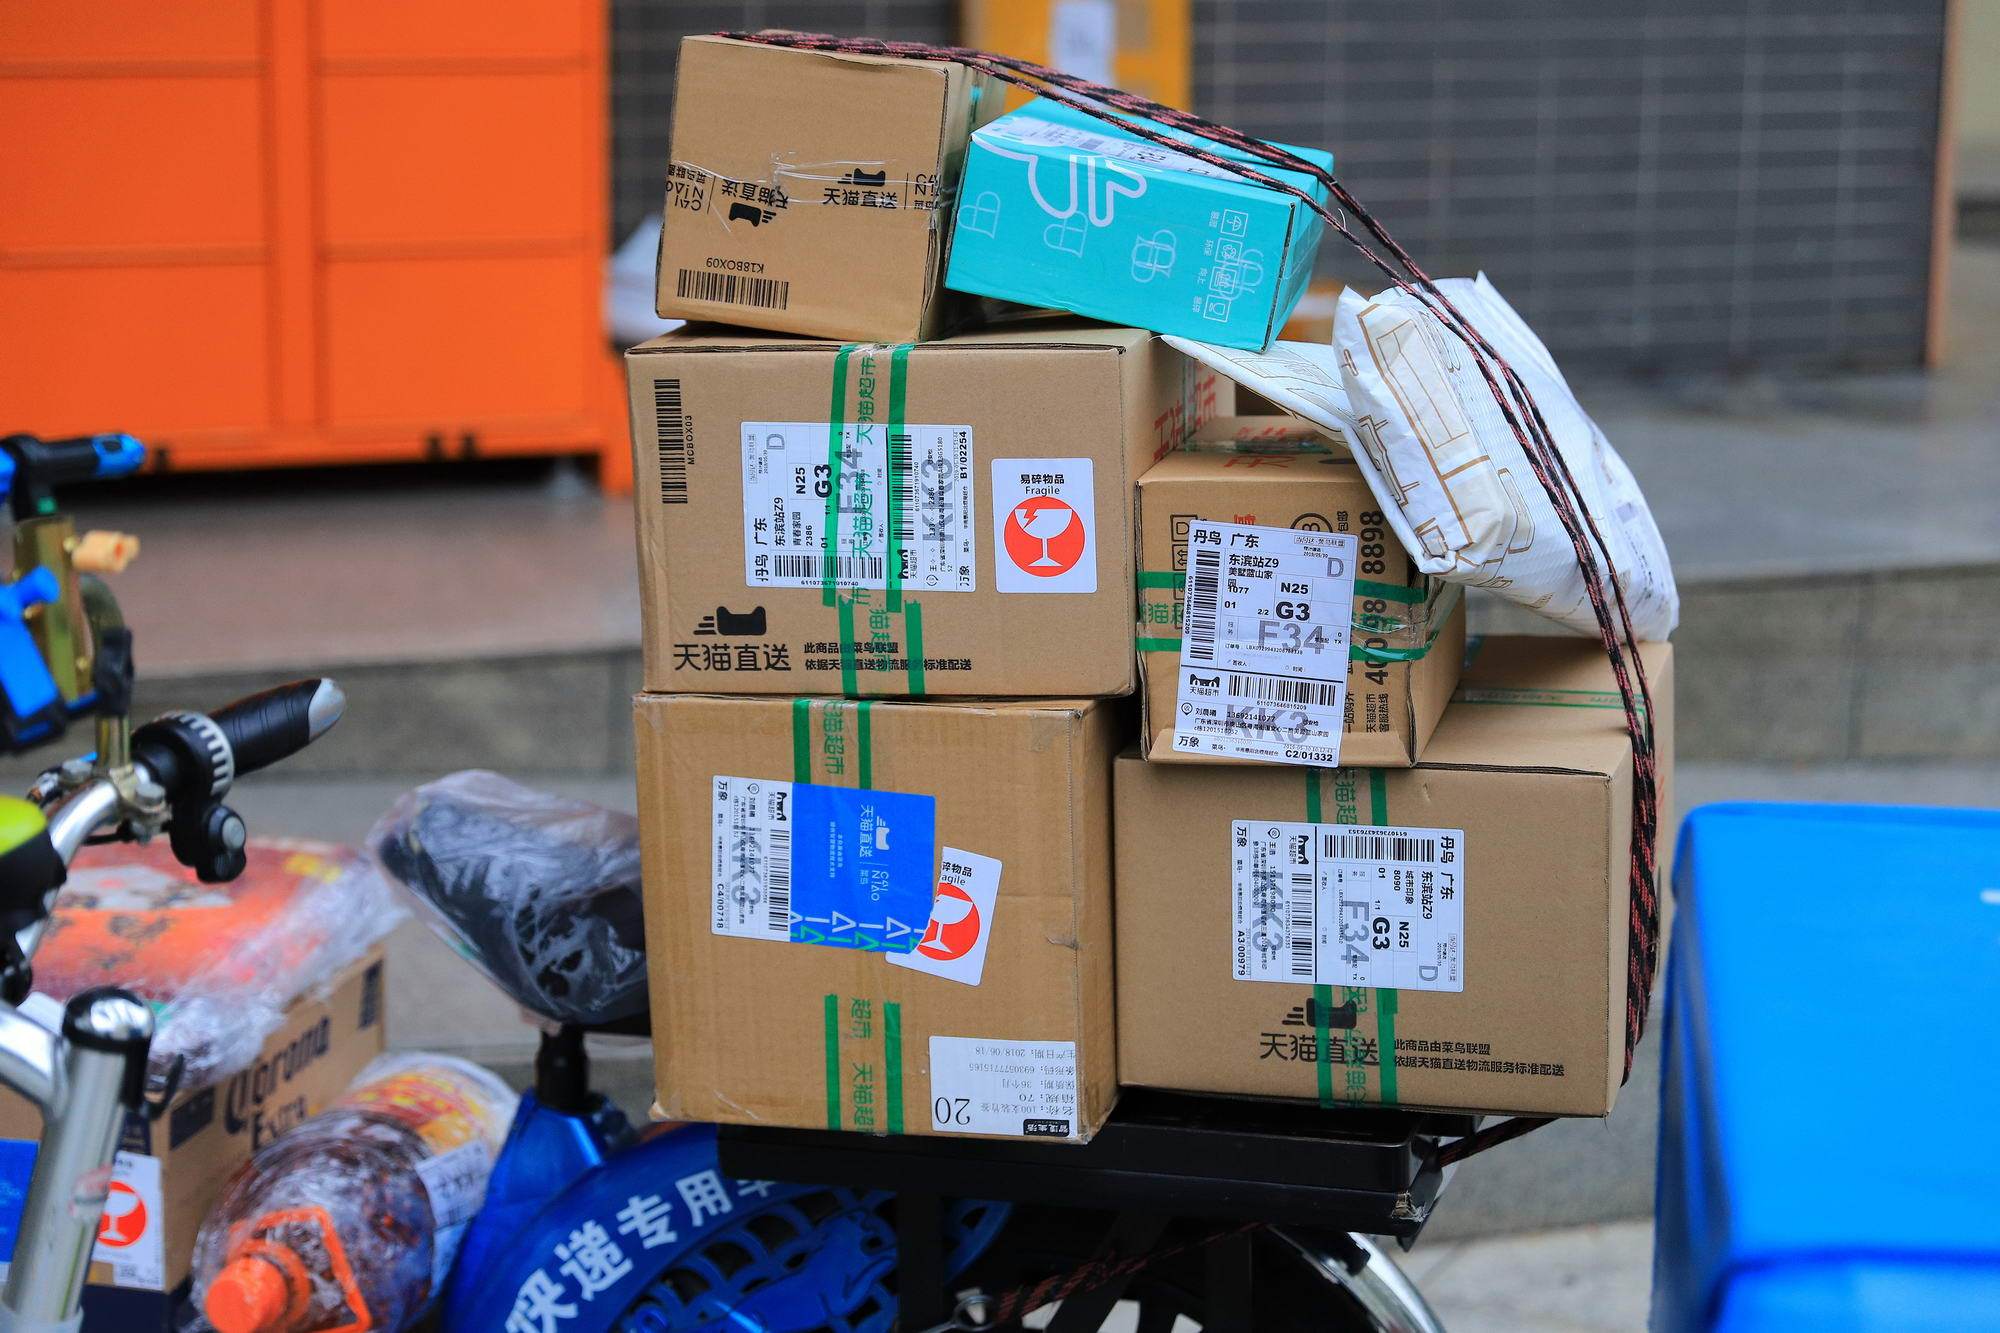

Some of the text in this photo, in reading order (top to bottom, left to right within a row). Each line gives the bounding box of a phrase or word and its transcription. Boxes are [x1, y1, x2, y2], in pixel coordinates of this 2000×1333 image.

[823, 187, 897, 209] 天猫直送
[706, 258, 764, 273] K18BOX09
[685, 415, 694, 465] MCBOX03
[766, 433, 784, 450] D
[959, 431, 968, 479] B1/02254
[796, 467, 806, 494] N25
[814, 464, 832, 498] G3
[1020, 474, 1064, 484] 易碎物品
[1026, 486, 1060, 497] Fragile
[774, 497, 785, 546] 东滨站Z9
[754, 518, 768, 582] 丹鸟 广东
[820, 537, 828, 549] 01
[1194, 530, 1259, 548] 丹鸟 广东
[1359, 511, 1386, 574] 8898
[1229, 554, 1279, 568] 东滨站Z9
[1327, 557, 1344, 577] D
[1281, 582, 1308, 594] N25
[1224, 601, 1236, 609] 01
[1276, 601, 1310, 621] G3
[673, 643, 792, 671] 天猫直送
[1189, 688, 1219, 696] 天猫超市
[1225, 704, 1309, 744] KK3
[1366, 693, 1377, 733] 天猫超市
[1378, 693, 1390, 733] 客服热线
[1178, 736, 1199, 748] 万象
[1285, 750, 1333, 762] C2/01332
[718, 781, 728, 801] 万象
[859, 804, 874, 858] 天猫直送
[1236, 827, 1247, 847] 万象
[1378, 867, 1385, 879] 01
[1393, 870, 1401, 891] 8090
[1440, 836, 1455, 900] 丹鸟 广东
[1405, 870, 1414, 905] 城市印象
[1421, 871, 1433, 920] 东滨站Z9
[716, 883, 725, 929] C4/00718
[1372, 917, 1390, 950] G3
[1399, 921, 1409, 948] N25
[1237, 930, 1245, 976] A3/00979
[1419, 965, 1438, 982] D
[1259, 1032, 1379, 1066] 天猫直送
[1394, 1038, 1491, 1056] 此商品由菜鸟联盟
[1394, 1055, 1565, 1077] 依据天猫直送物流服务标准配送
[935, 1096, 970, 1126] 20
